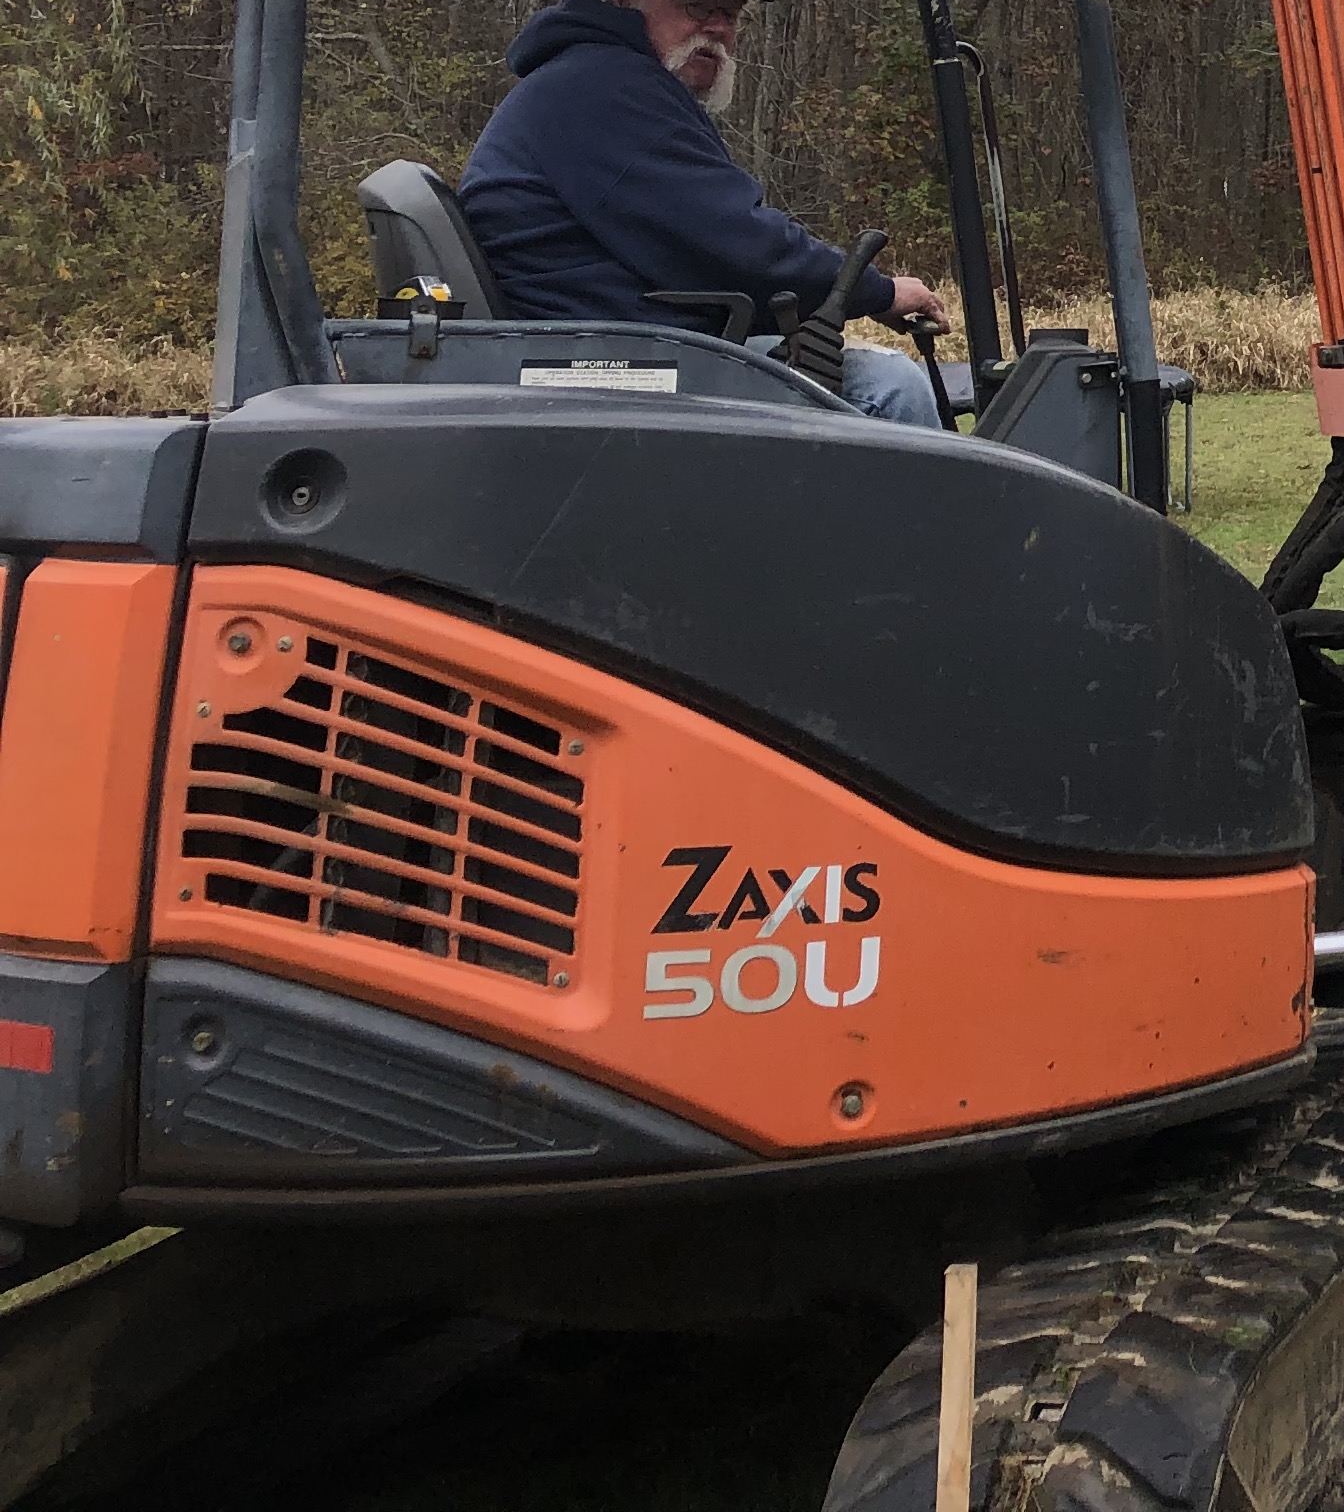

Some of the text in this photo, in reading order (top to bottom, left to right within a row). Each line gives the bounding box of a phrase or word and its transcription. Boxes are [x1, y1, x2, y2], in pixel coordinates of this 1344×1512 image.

[571, 360, 630, 369] IMPORTANT
[650, 845, 881, 939] ZAXIS
[643, 936, 881, 1020] 50U
